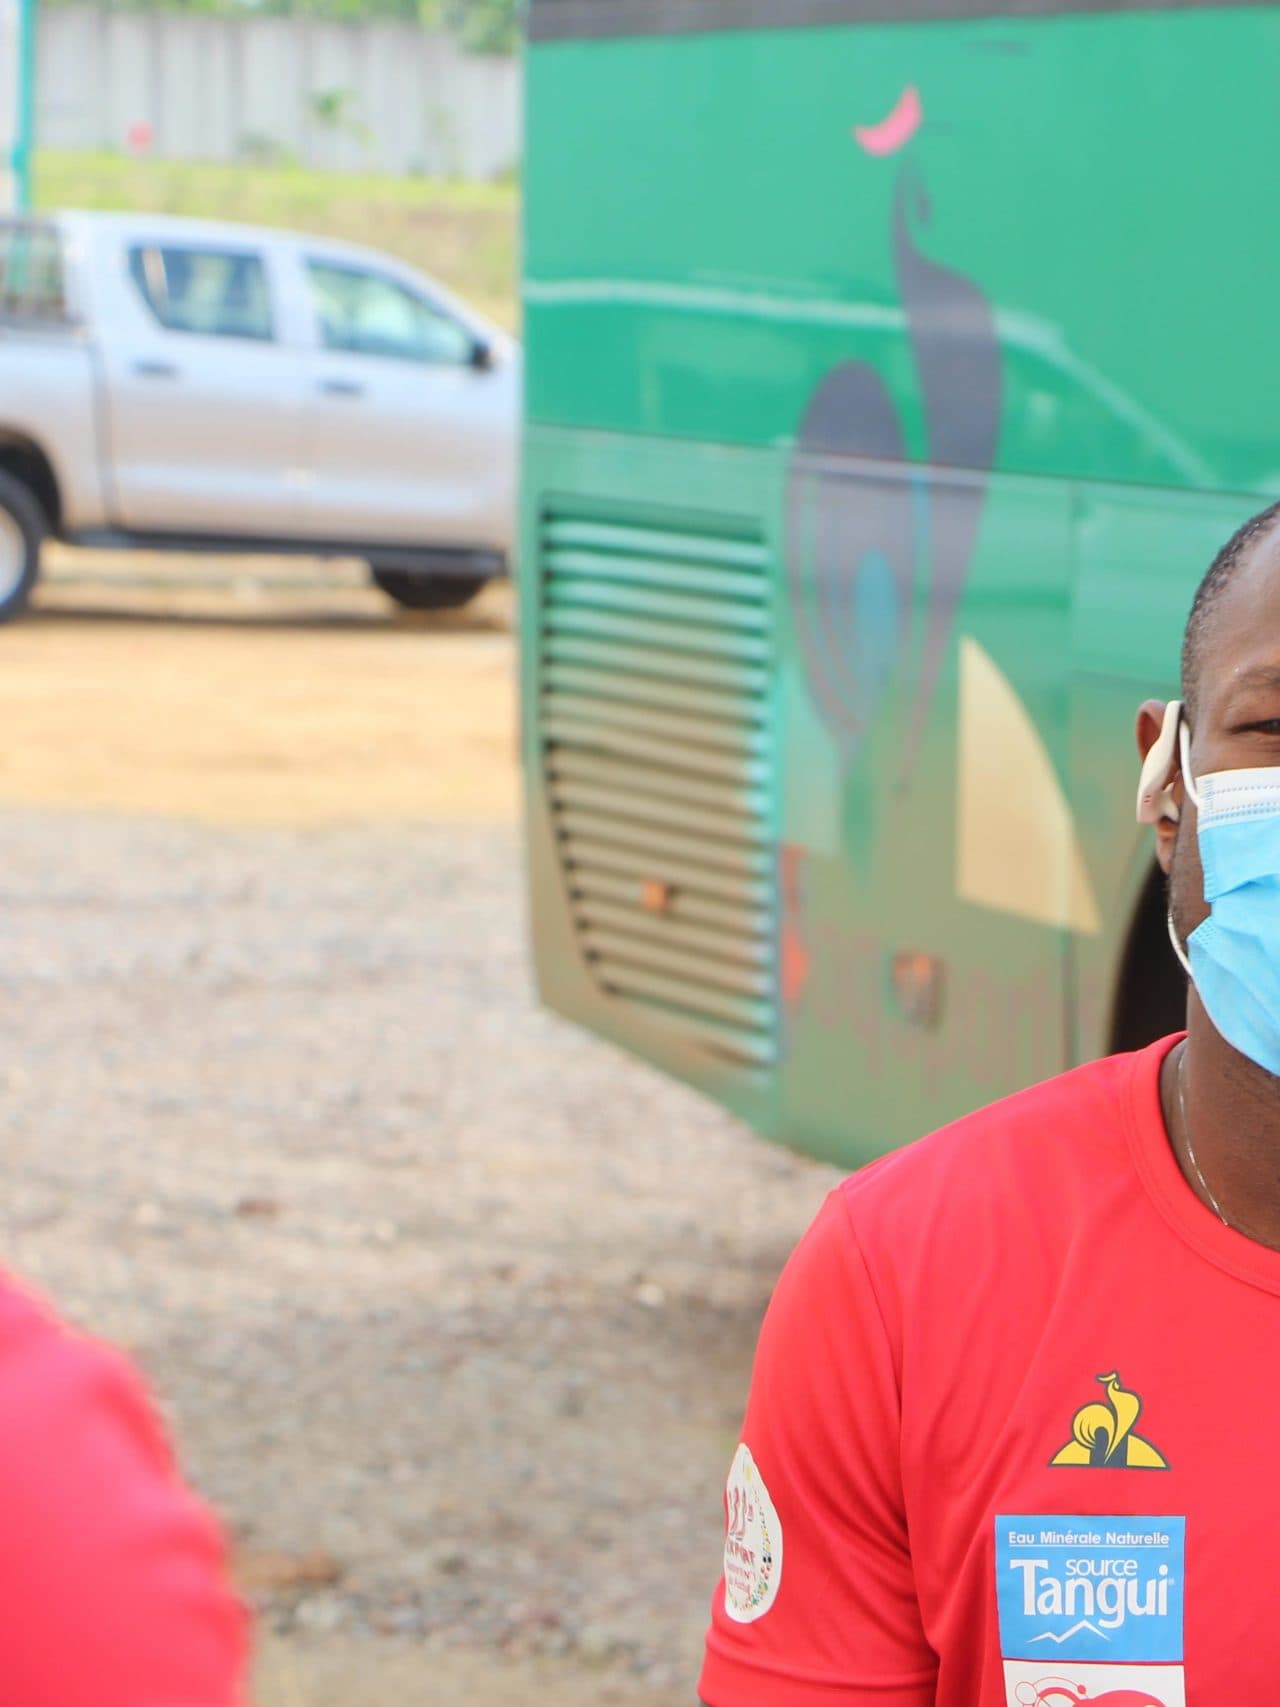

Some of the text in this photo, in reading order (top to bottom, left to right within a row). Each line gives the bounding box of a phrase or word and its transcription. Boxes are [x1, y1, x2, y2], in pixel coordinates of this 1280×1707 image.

[1008, 1530, 1170, 1546] Eau Minérale Naturelle
[1065, 1558, 1138, 1577] source
[1010, 1559, 1169, 1629] Tangui
